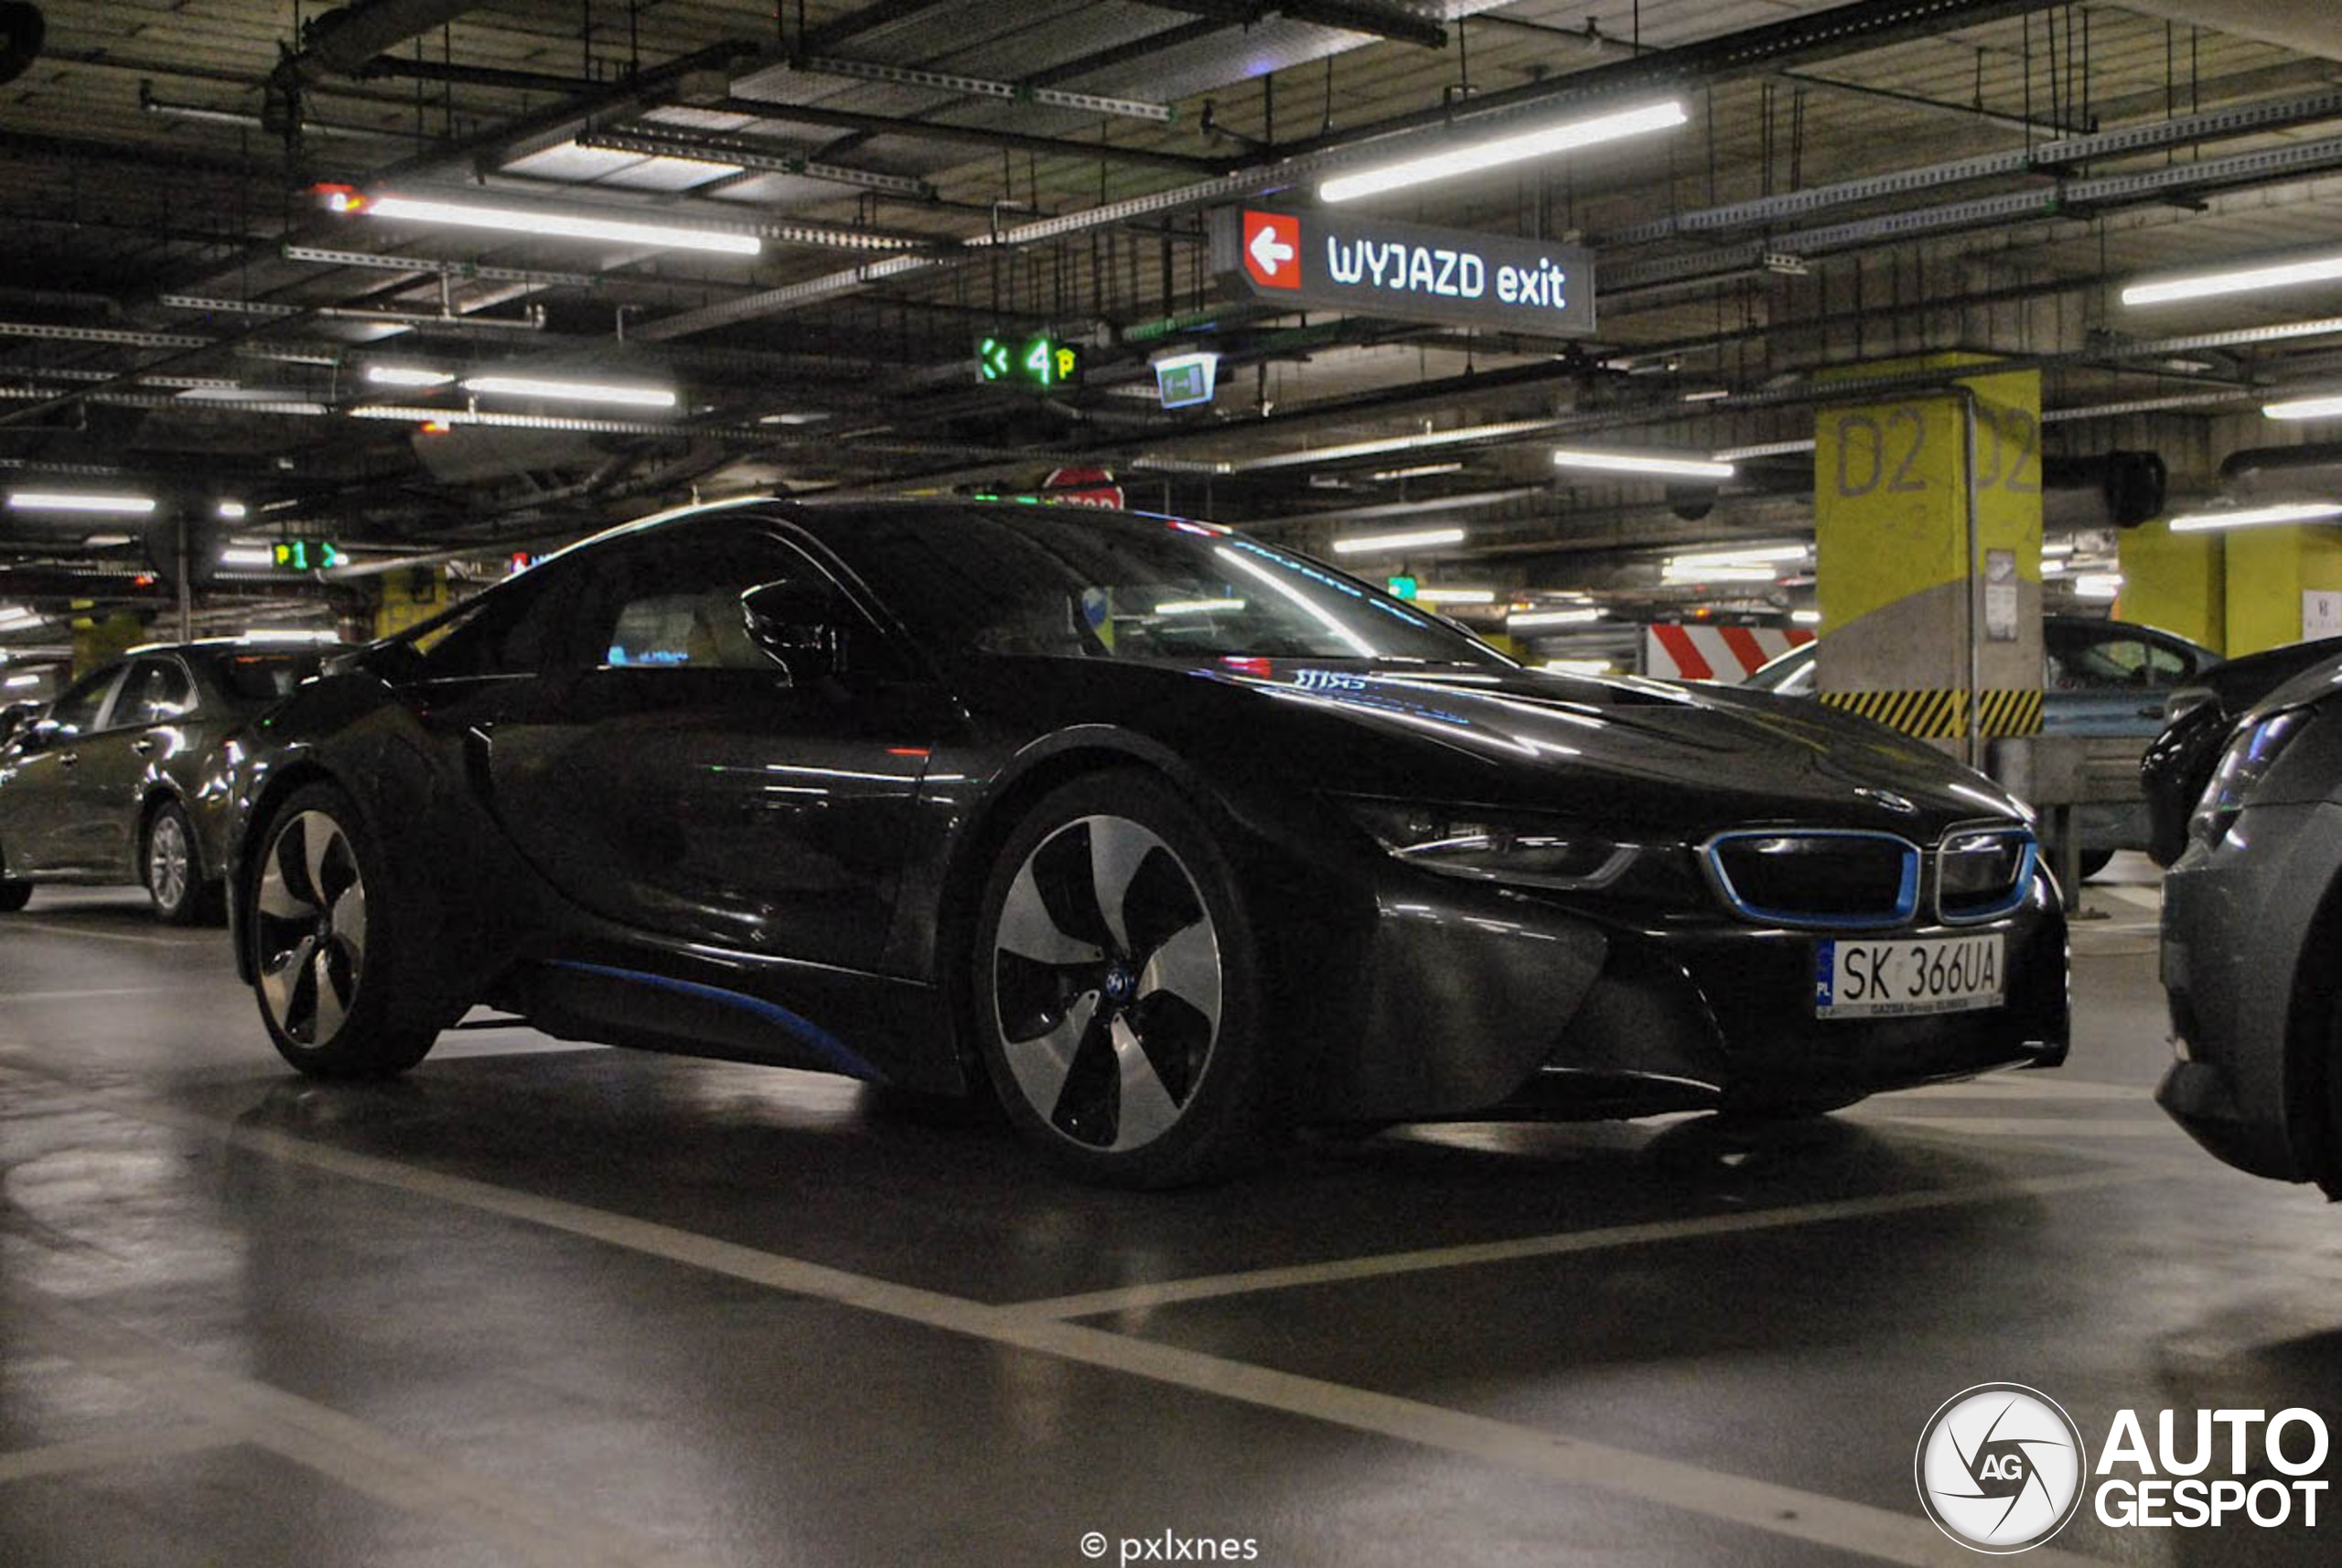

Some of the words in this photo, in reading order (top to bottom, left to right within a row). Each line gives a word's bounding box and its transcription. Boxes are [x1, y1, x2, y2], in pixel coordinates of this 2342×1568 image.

[1327, 236, 1485, 298] WYJAZD
[1496, 257, 1566, 308] exit
[1026, 339, 1051, 384] 4
[1837, 407, 1928, 496] D2
[1816, 981, 1831, 997] PL
[1842, 946, 1893, 1000] SK
[1907, 940, 1995, 997] 366UA
